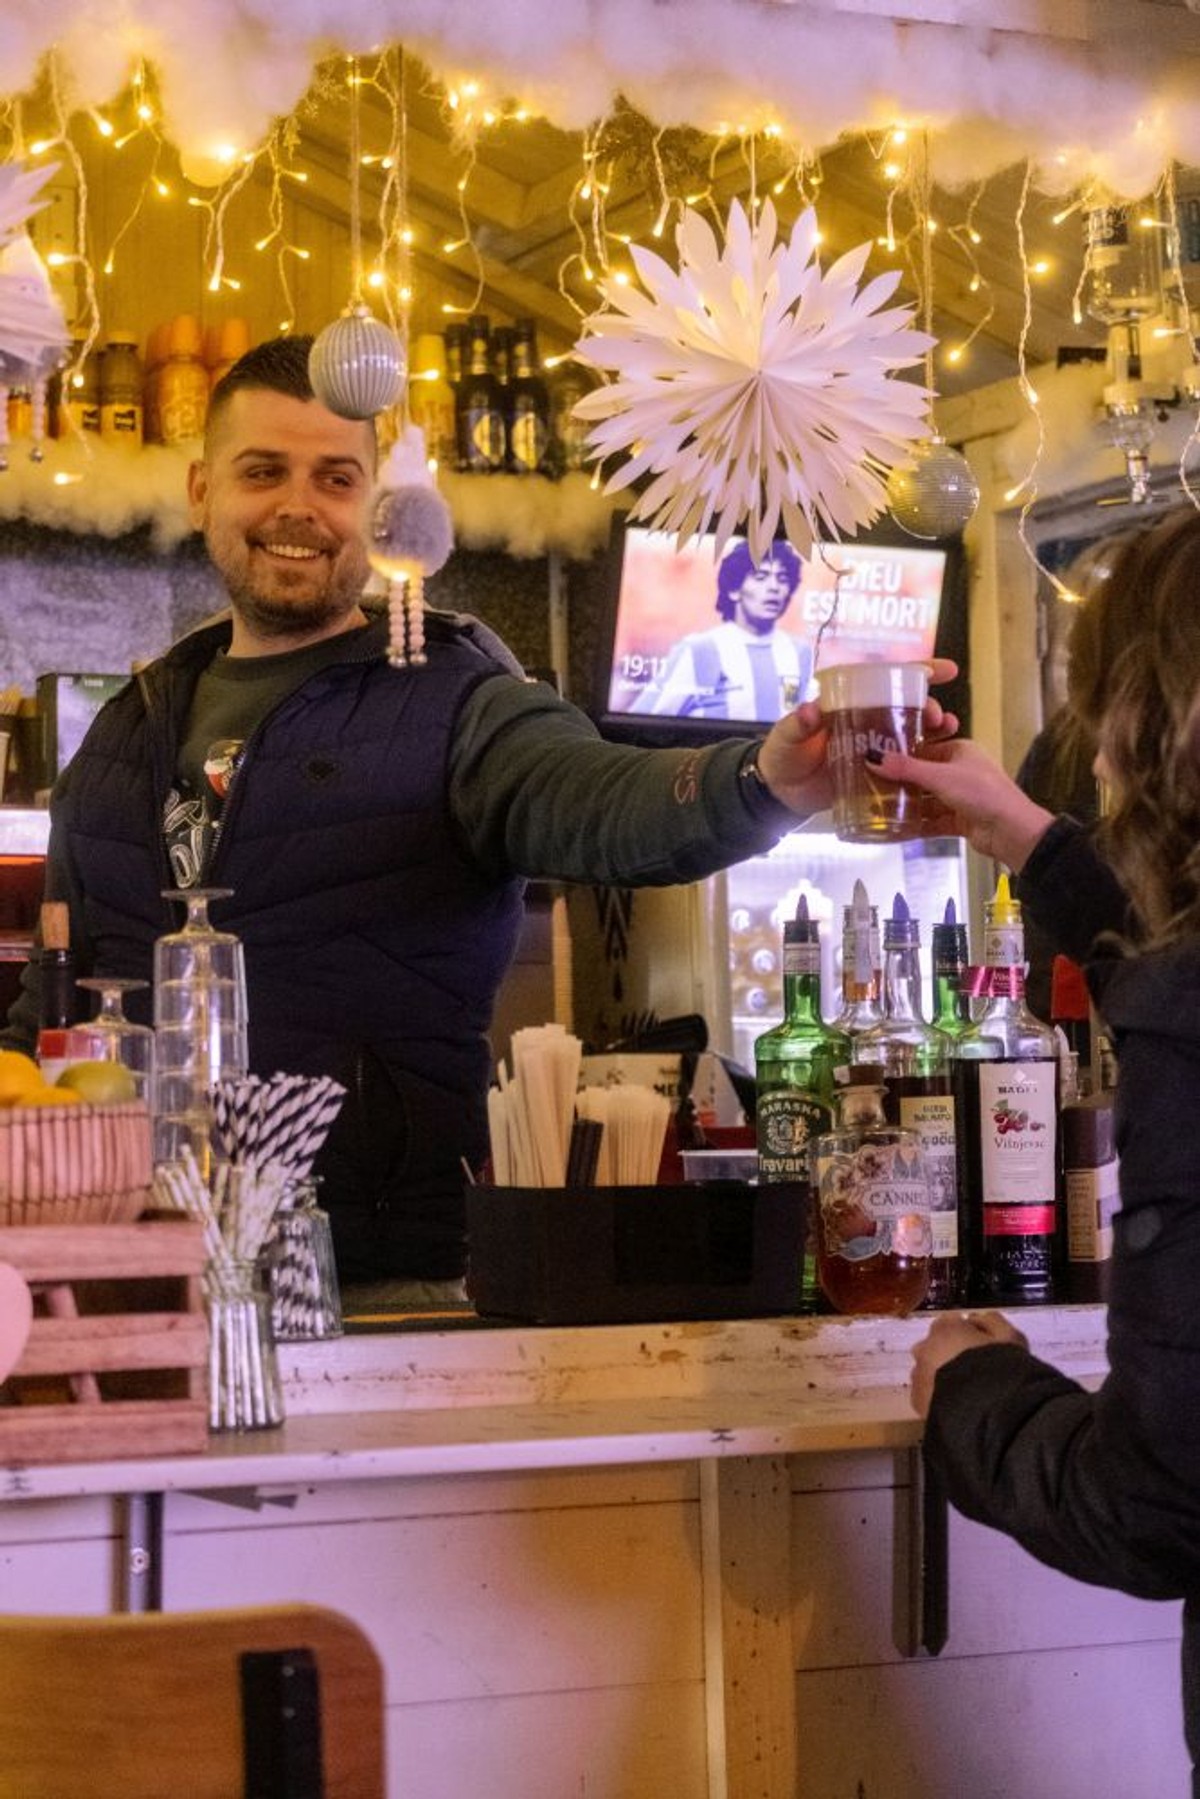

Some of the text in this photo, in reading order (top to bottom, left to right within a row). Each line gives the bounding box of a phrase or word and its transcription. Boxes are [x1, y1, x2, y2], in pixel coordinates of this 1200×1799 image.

[841, 559, 903, 593] DIEU
[803, 589, 933, 629] EST MORT
[623, 654, 668, 678] 19:11
